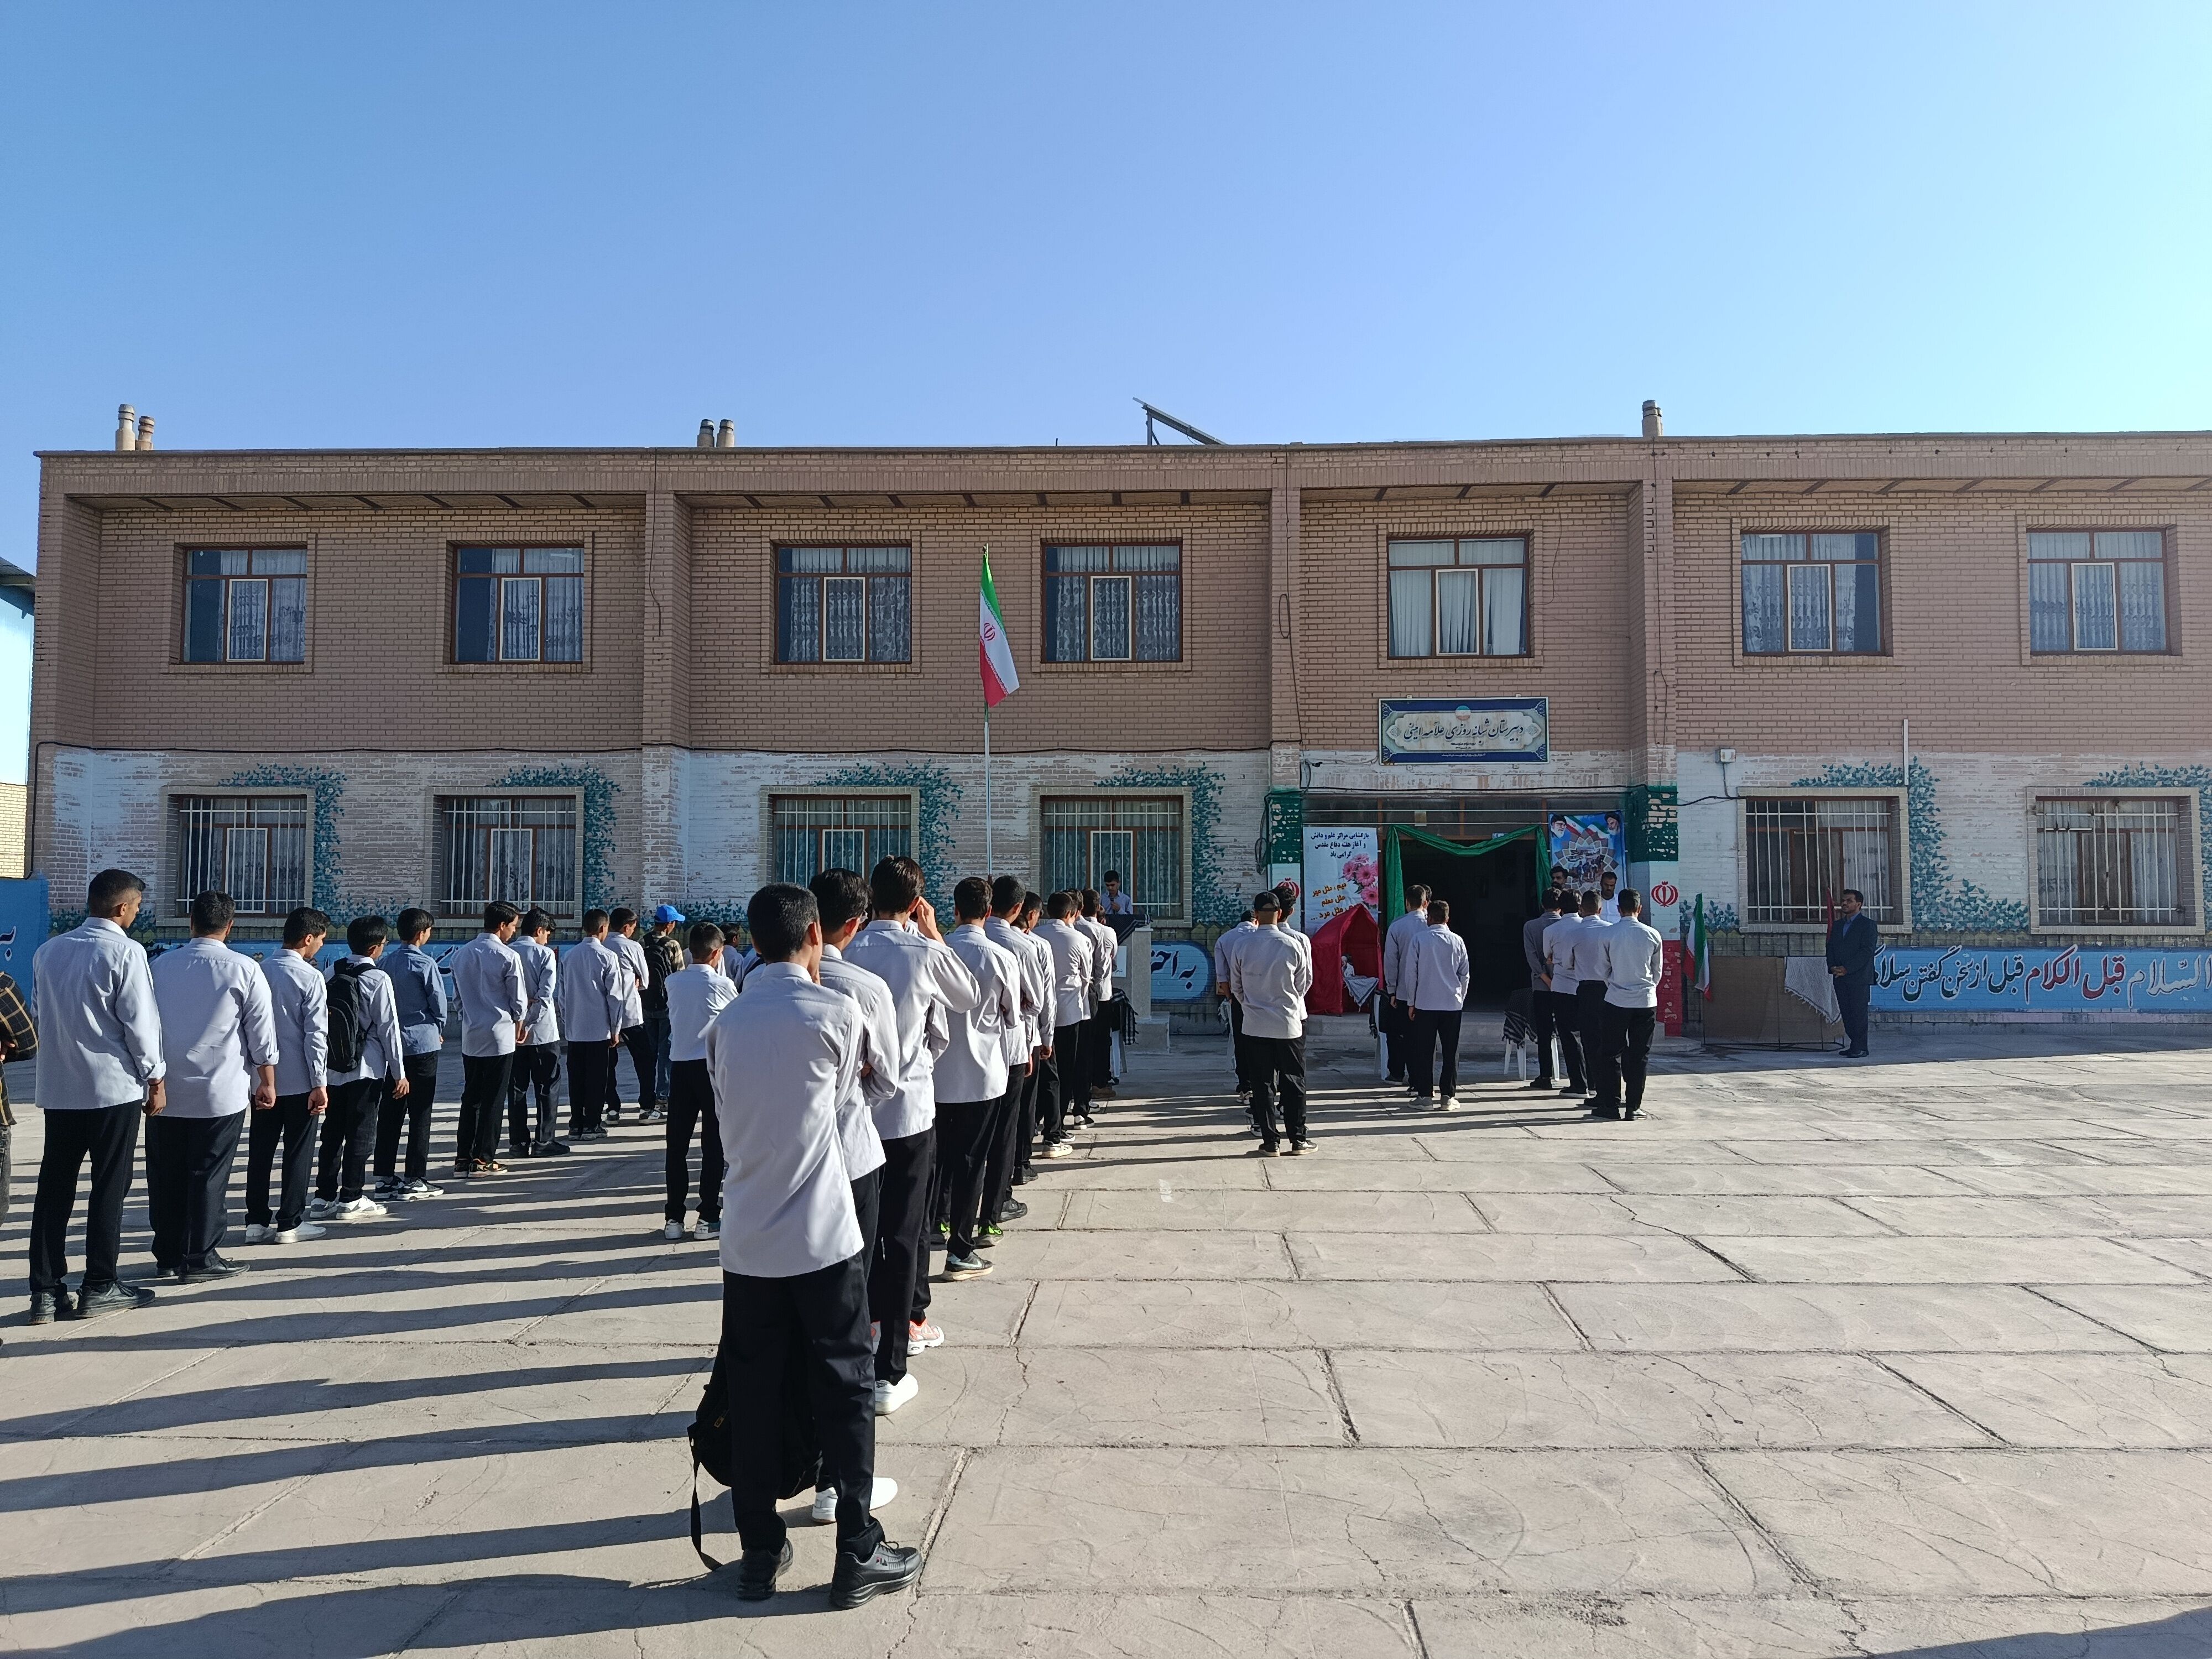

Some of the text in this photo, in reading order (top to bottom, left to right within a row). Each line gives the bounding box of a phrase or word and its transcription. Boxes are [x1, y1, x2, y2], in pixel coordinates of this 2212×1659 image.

[1404, 722, 1421, 740] امینی
[1488, 719, 1524, 742] دبیرستان
[1329, 841, 1340, 849] دفاع
[1337, 851, 1352, 859] گرامی
[1352, 840, 1361, 849] آغاز
[1321, 894, 1345, 907] مثل معلم
[1322, 885, 1333, 894] مثل
[1902, 945, 1962, 1003] گفتن
[1939, 957, 1974, 1000] سخن
[1966, 954, 1989, 989] از
[1987, 954, 2025, 994] قبل
[2025, 944, 2081, 1005] الکلام
[2082, 954, 2125, 1000] قبل
